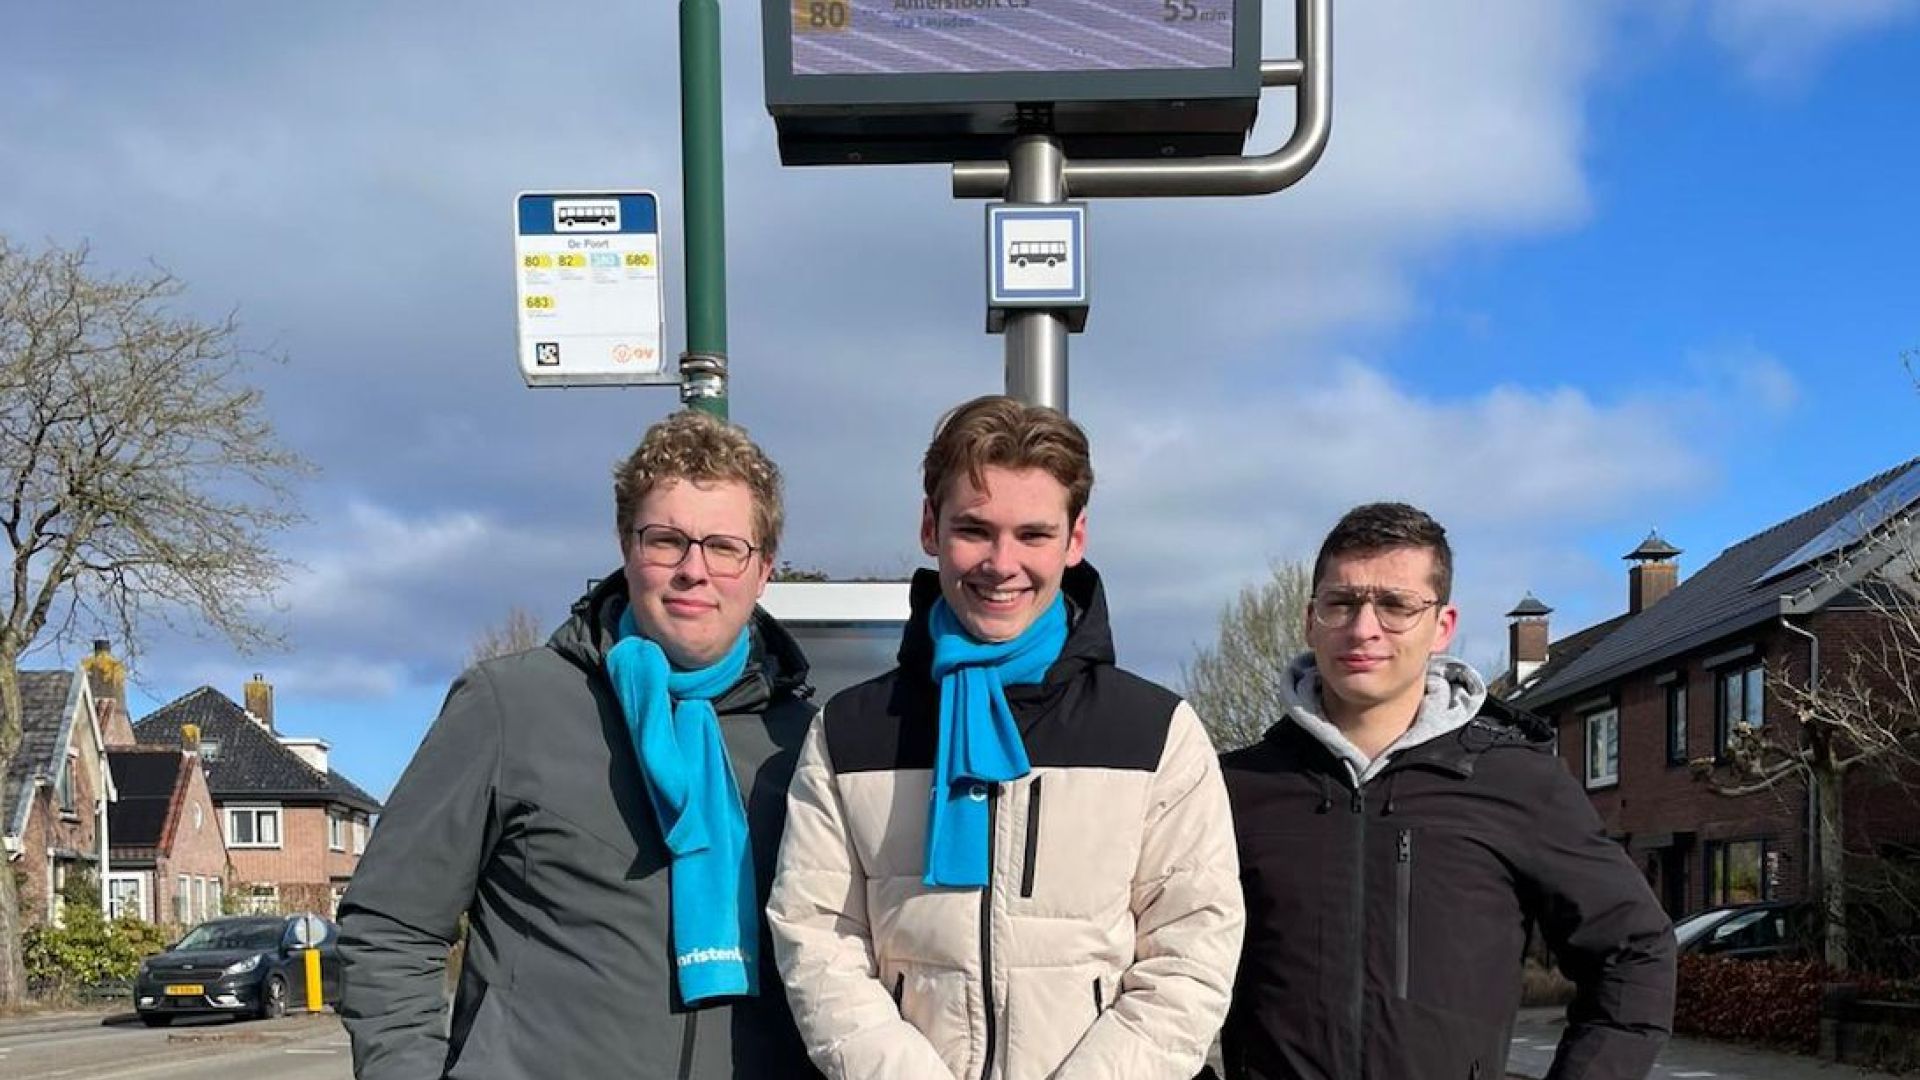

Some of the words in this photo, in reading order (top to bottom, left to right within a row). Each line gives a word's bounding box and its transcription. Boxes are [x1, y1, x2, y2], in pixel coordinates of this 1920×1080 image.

[810, 1, 845, 28] 80
[1163, 0, 1197, 21] 55
[567, 239, 581, 249] De
[584, 239, 609, 249] Poort
[524, 255, 540, 267] 80
[558, 255, 573, 267] 82
[625, 254, 650, 266] 680
[526, 296, 549, 309] 683
